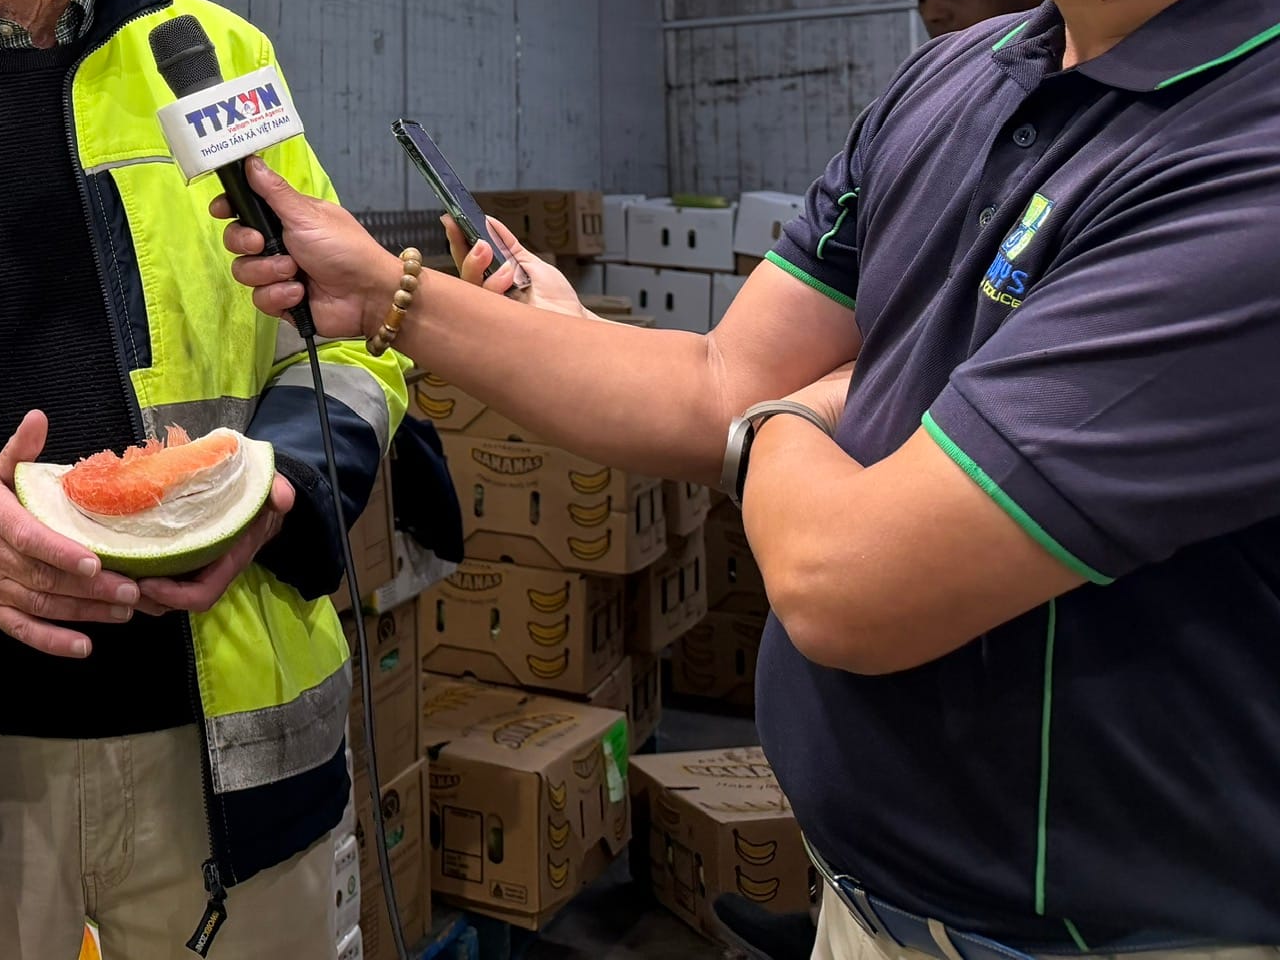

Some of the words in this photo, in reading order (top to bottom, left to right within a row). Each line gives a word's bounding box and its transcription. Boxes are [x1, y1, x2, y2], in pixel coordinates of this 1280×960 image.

[250, 114, 265, 125] News
[265, 107, 285, 120] Agency
[272, 115, 290, 129] NAM
